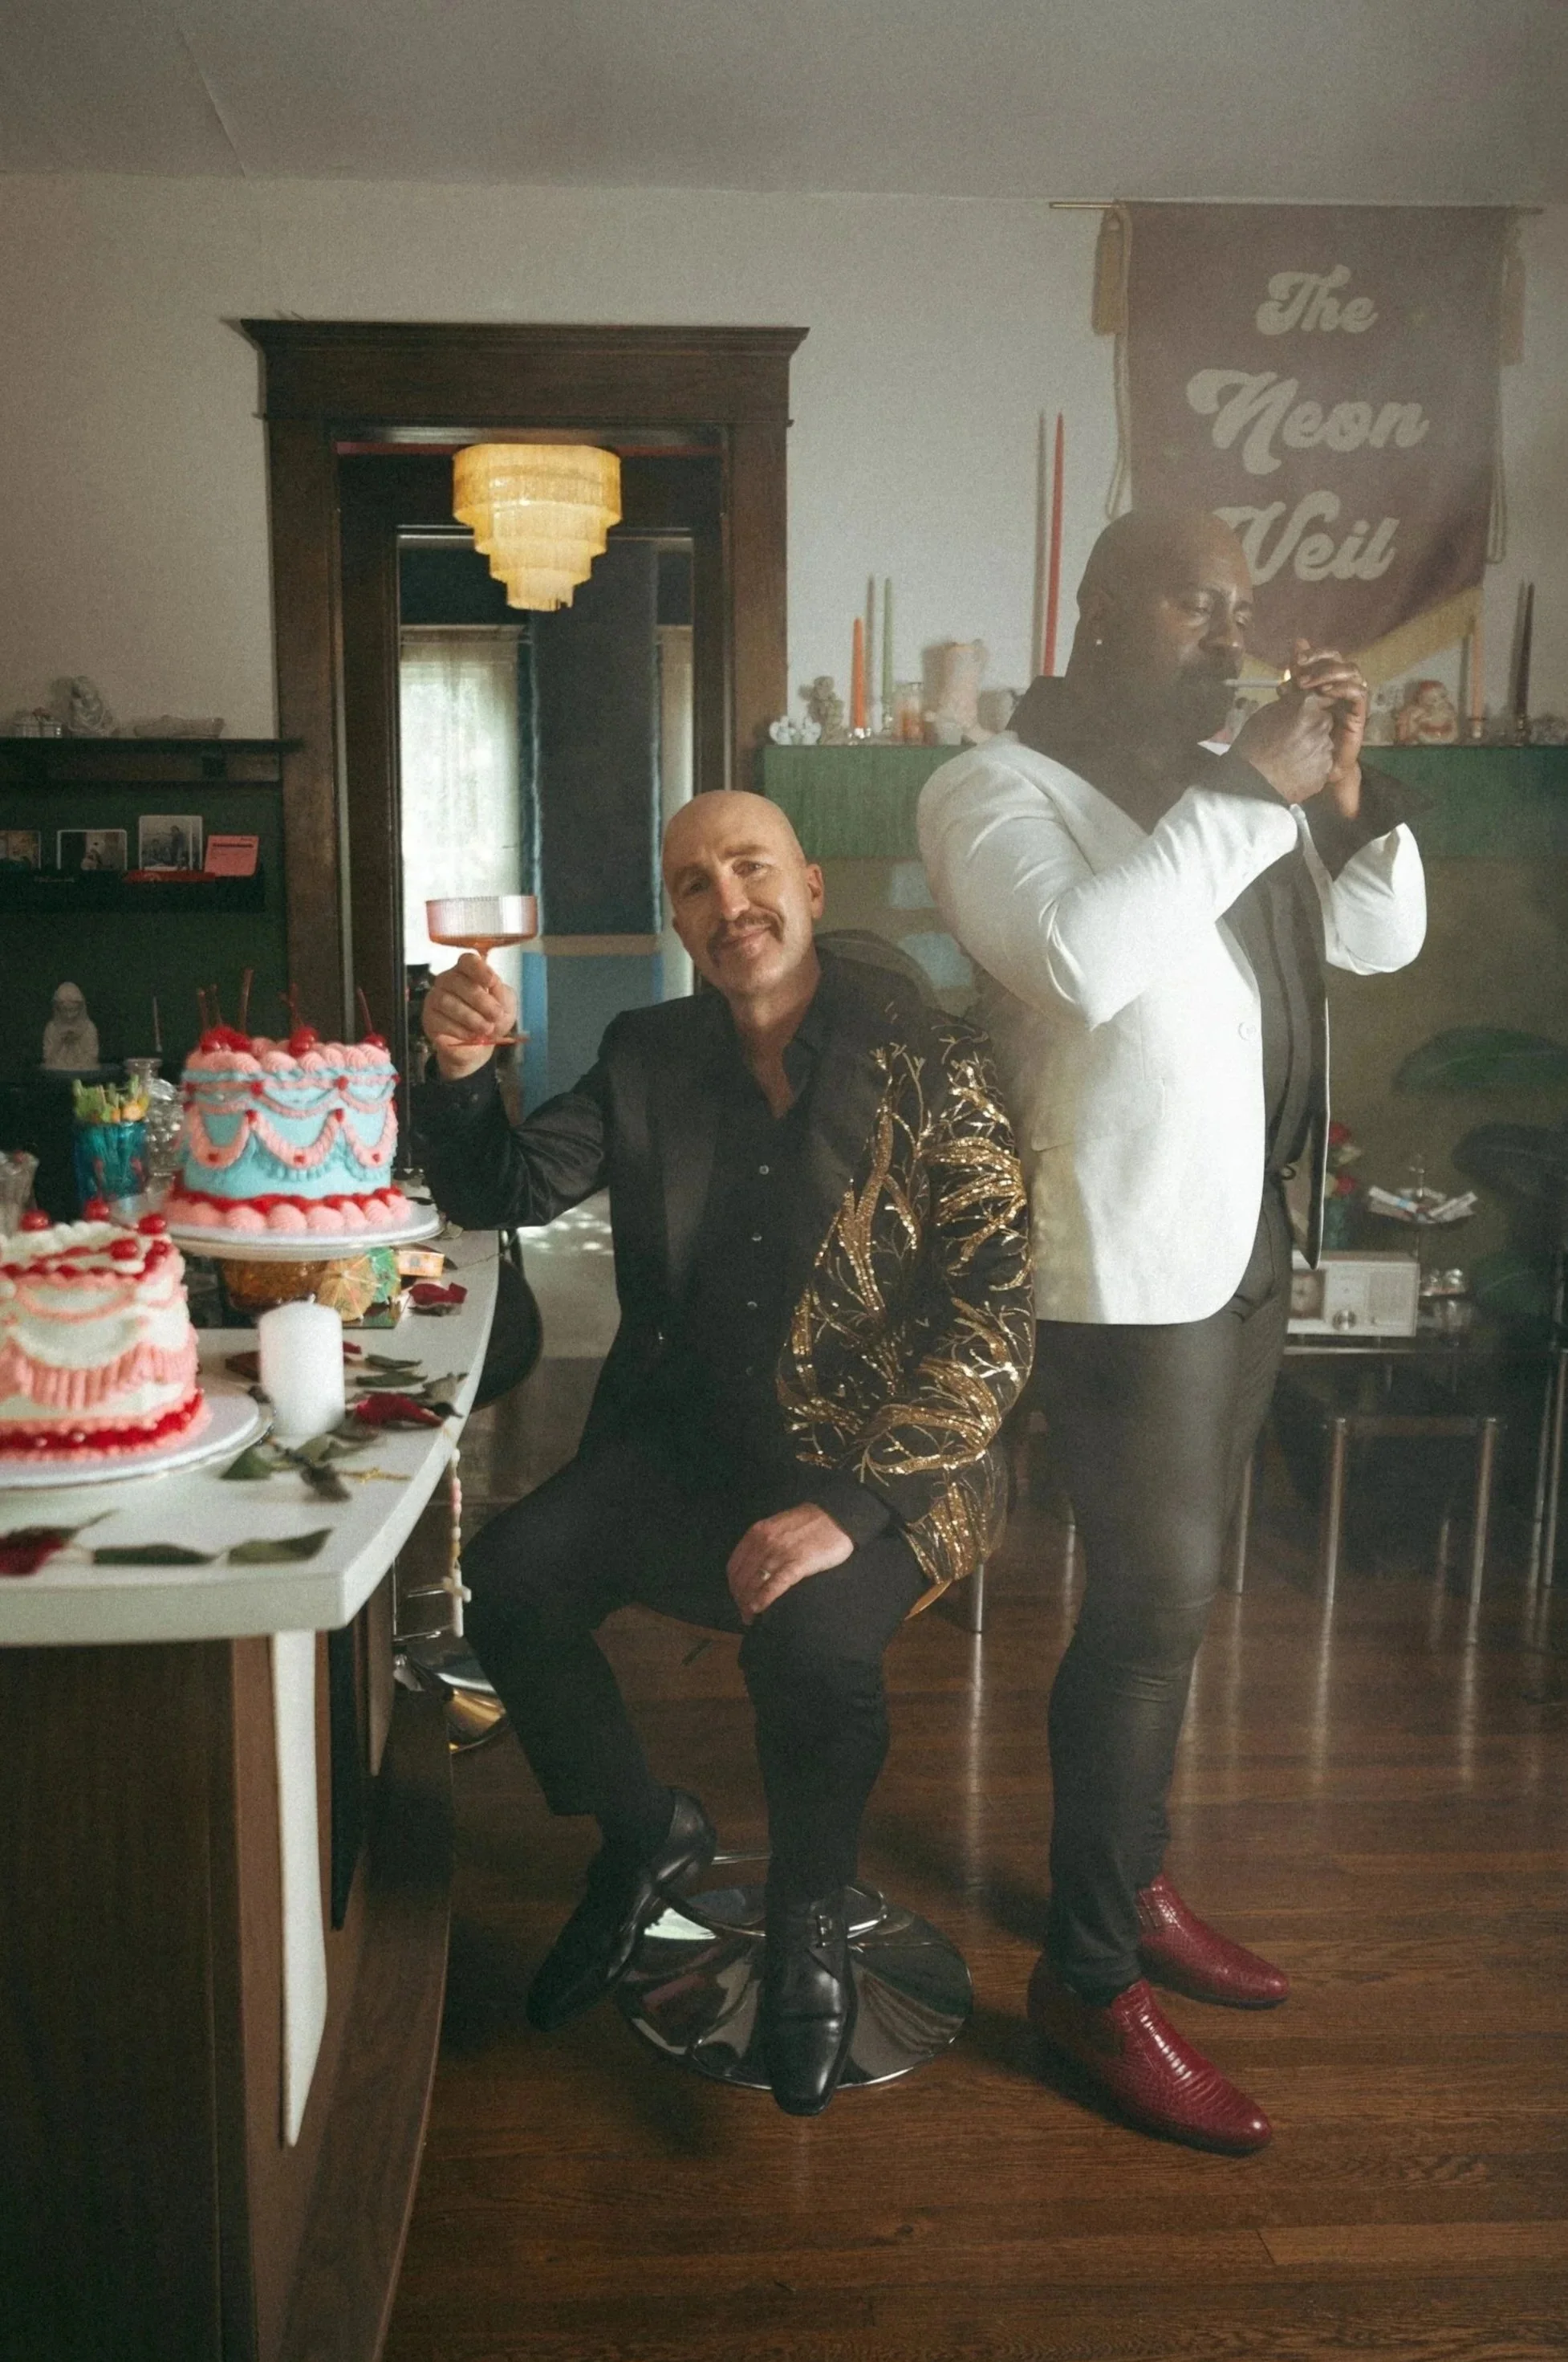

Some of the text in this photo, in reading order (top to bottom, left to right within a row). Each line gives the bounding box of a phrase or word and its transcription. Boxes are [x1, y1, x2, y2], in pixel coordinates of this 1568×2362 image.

[1256, 265, 1379, 335] The
[1186, 368, 1430, 475] Neon
[1213, 490, 1399, 586] Veil
